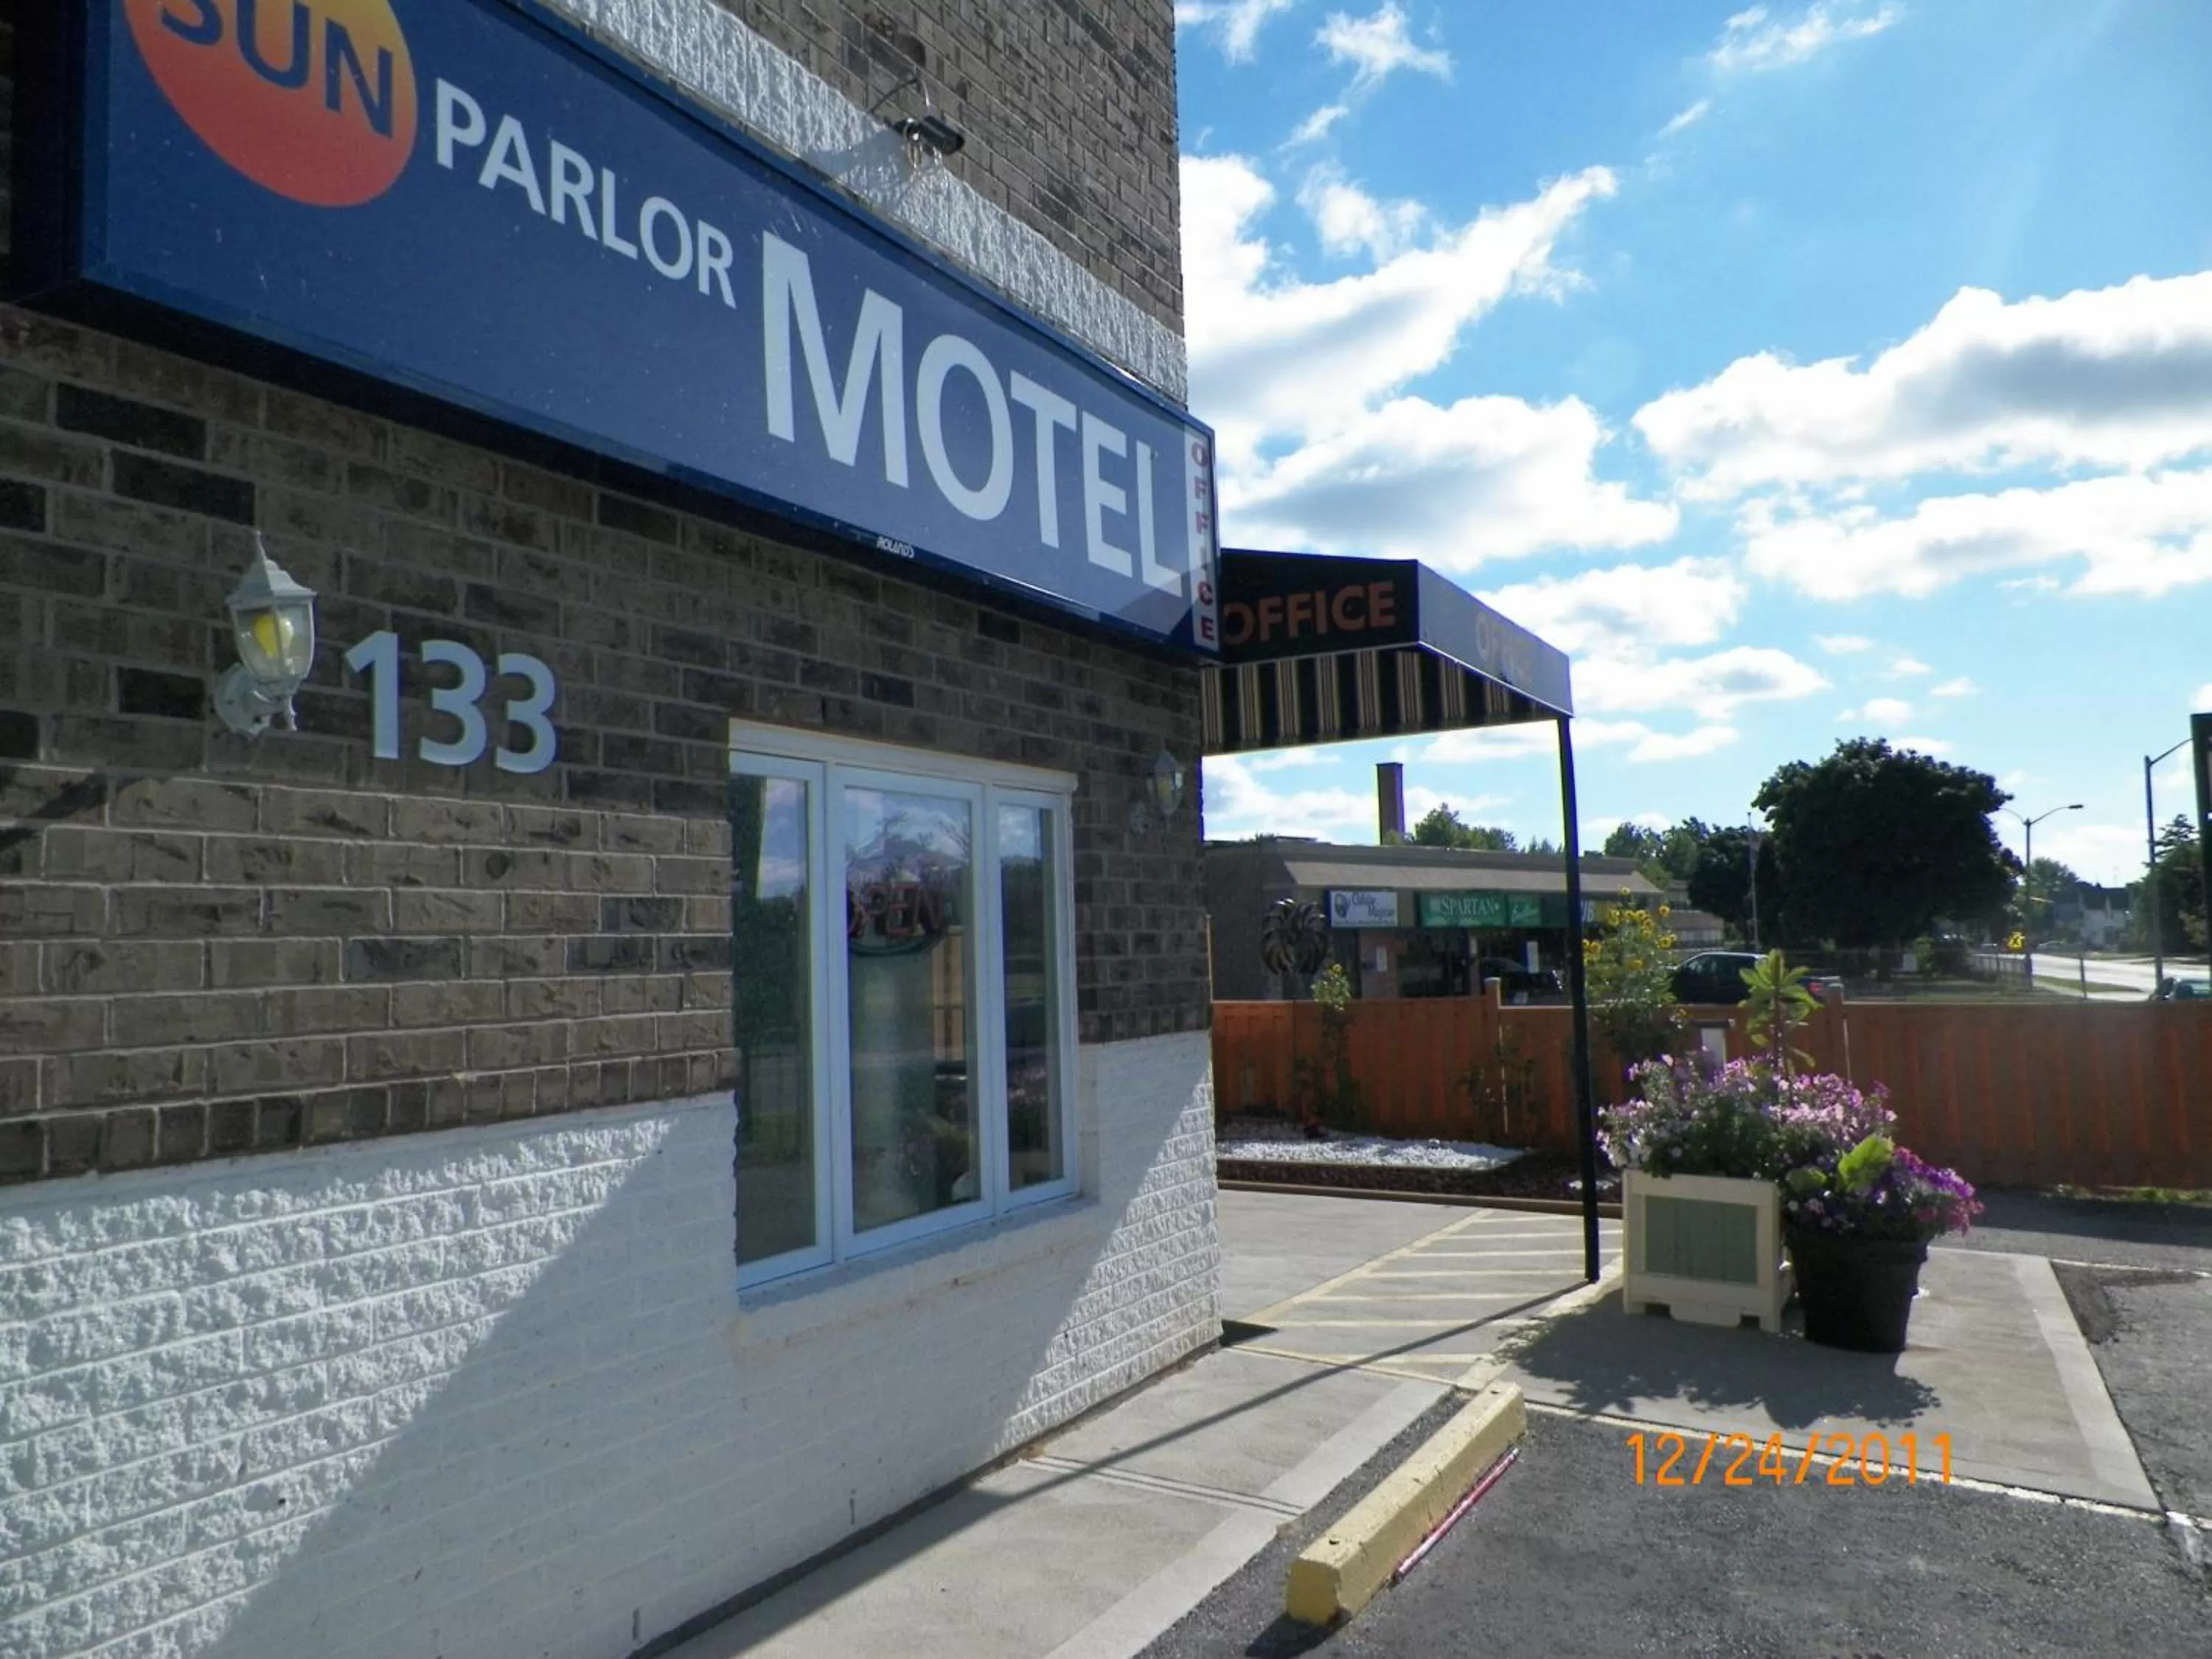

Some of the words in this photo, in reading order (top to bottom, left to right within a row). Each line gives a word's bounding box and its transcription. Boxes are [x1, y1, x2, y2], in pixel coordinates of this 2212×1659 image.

[436, 77, 735, 309] PARLOR
[763, 230, 1182, 598] MOTEL
[1191, 442, 1214, 641] OFFICE
[1222, 581, 1396, 645] OFFICE
[345, 630, 557, 773] 133
